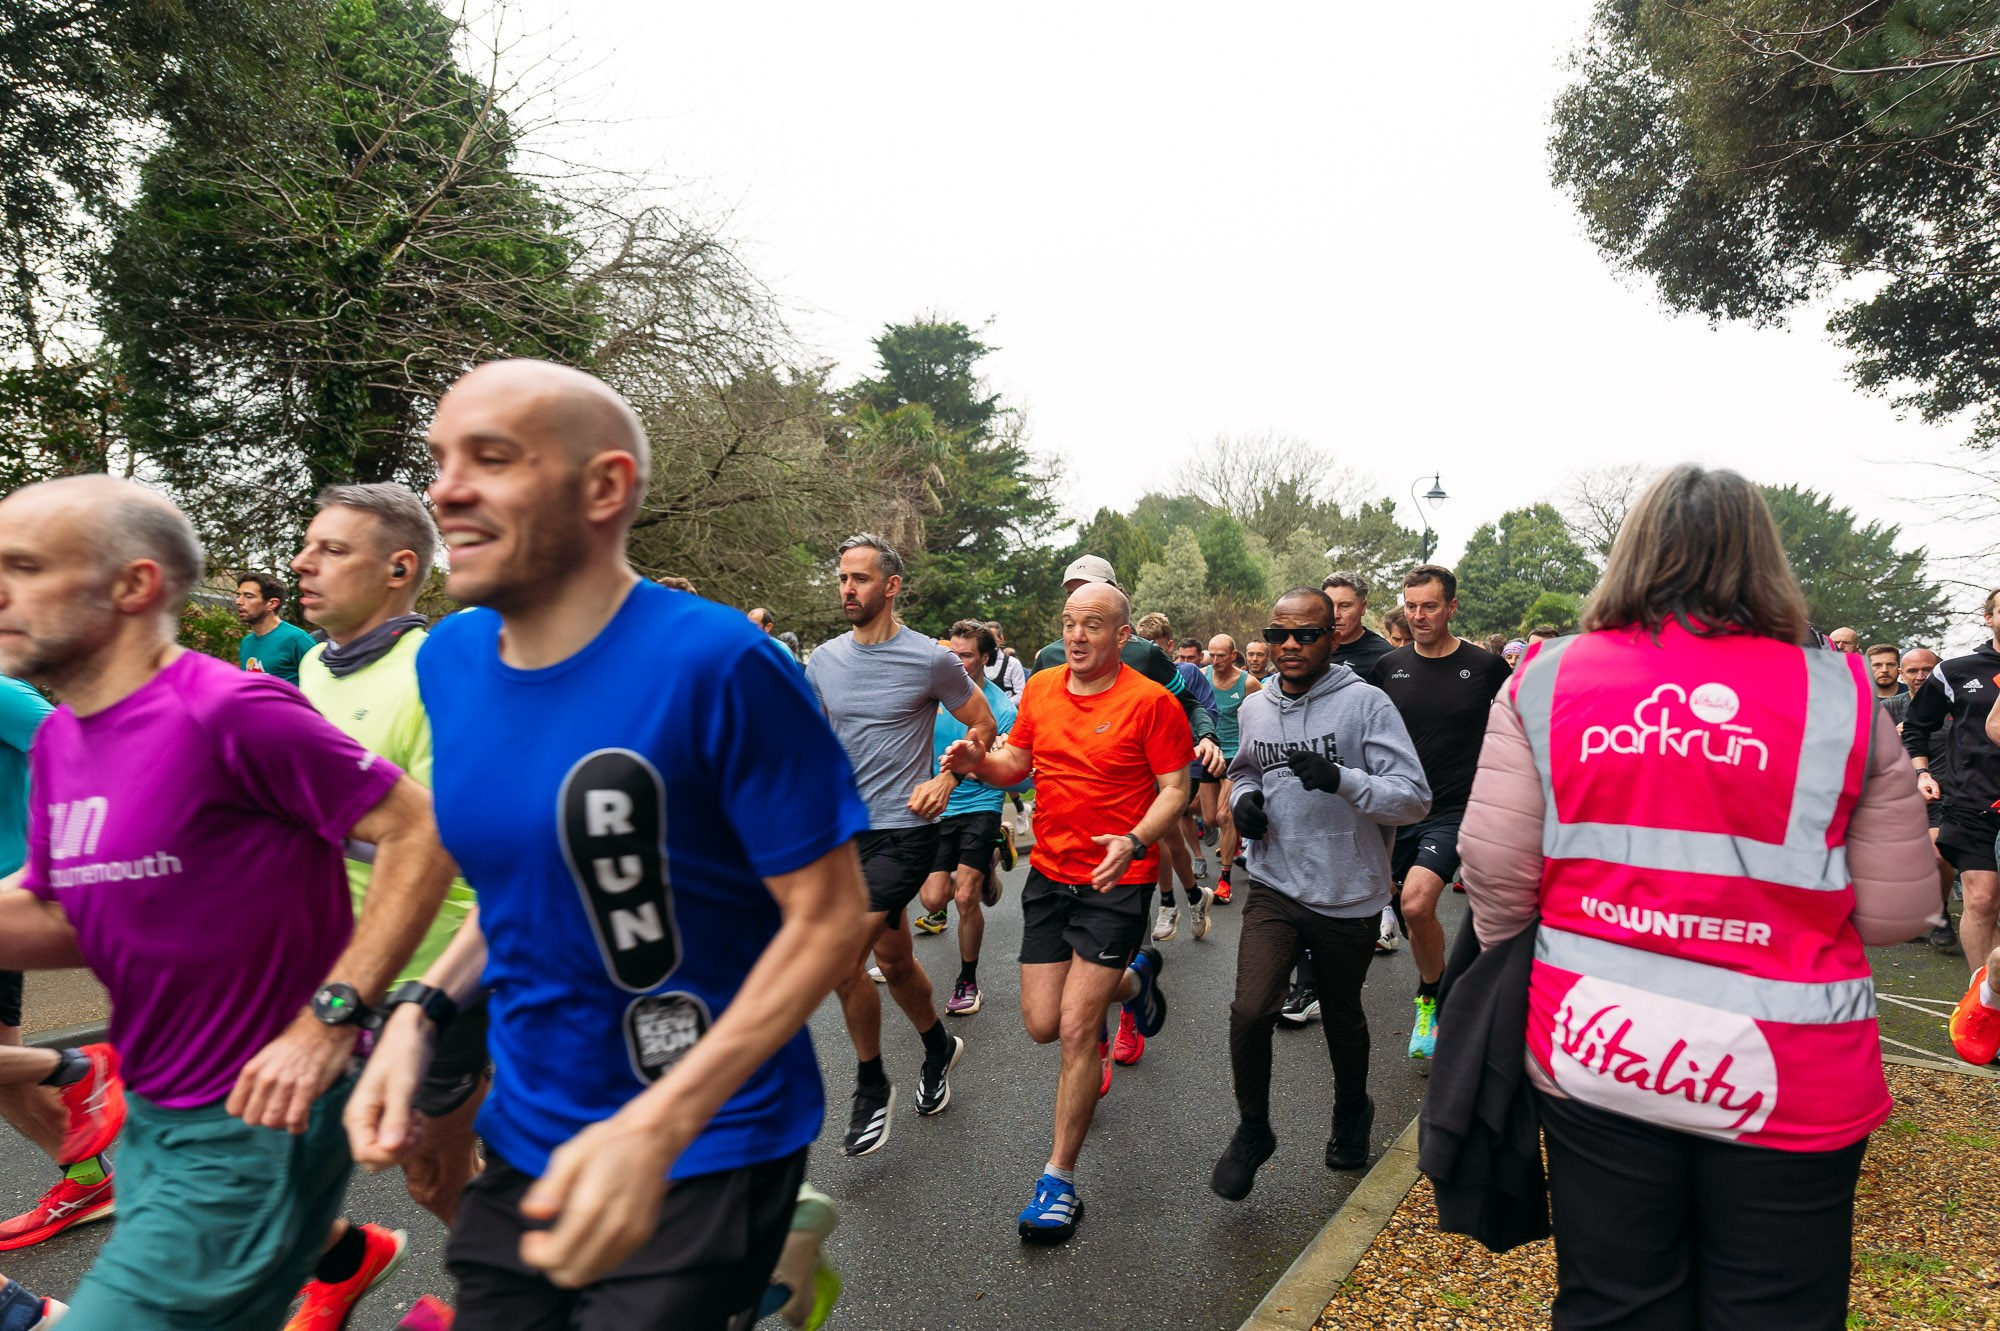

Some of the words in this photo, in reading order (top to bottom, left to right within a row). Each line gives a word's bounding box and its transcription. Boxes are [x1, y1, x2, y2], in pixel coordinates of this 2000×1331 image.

[1579, 706, 1769, 771] parkrun
[585, 789, 664, 951] RUN
[1581, 896, 1772, 947] VOLUNTEER
[1561, 1004, 1764, 1130] Vitality
